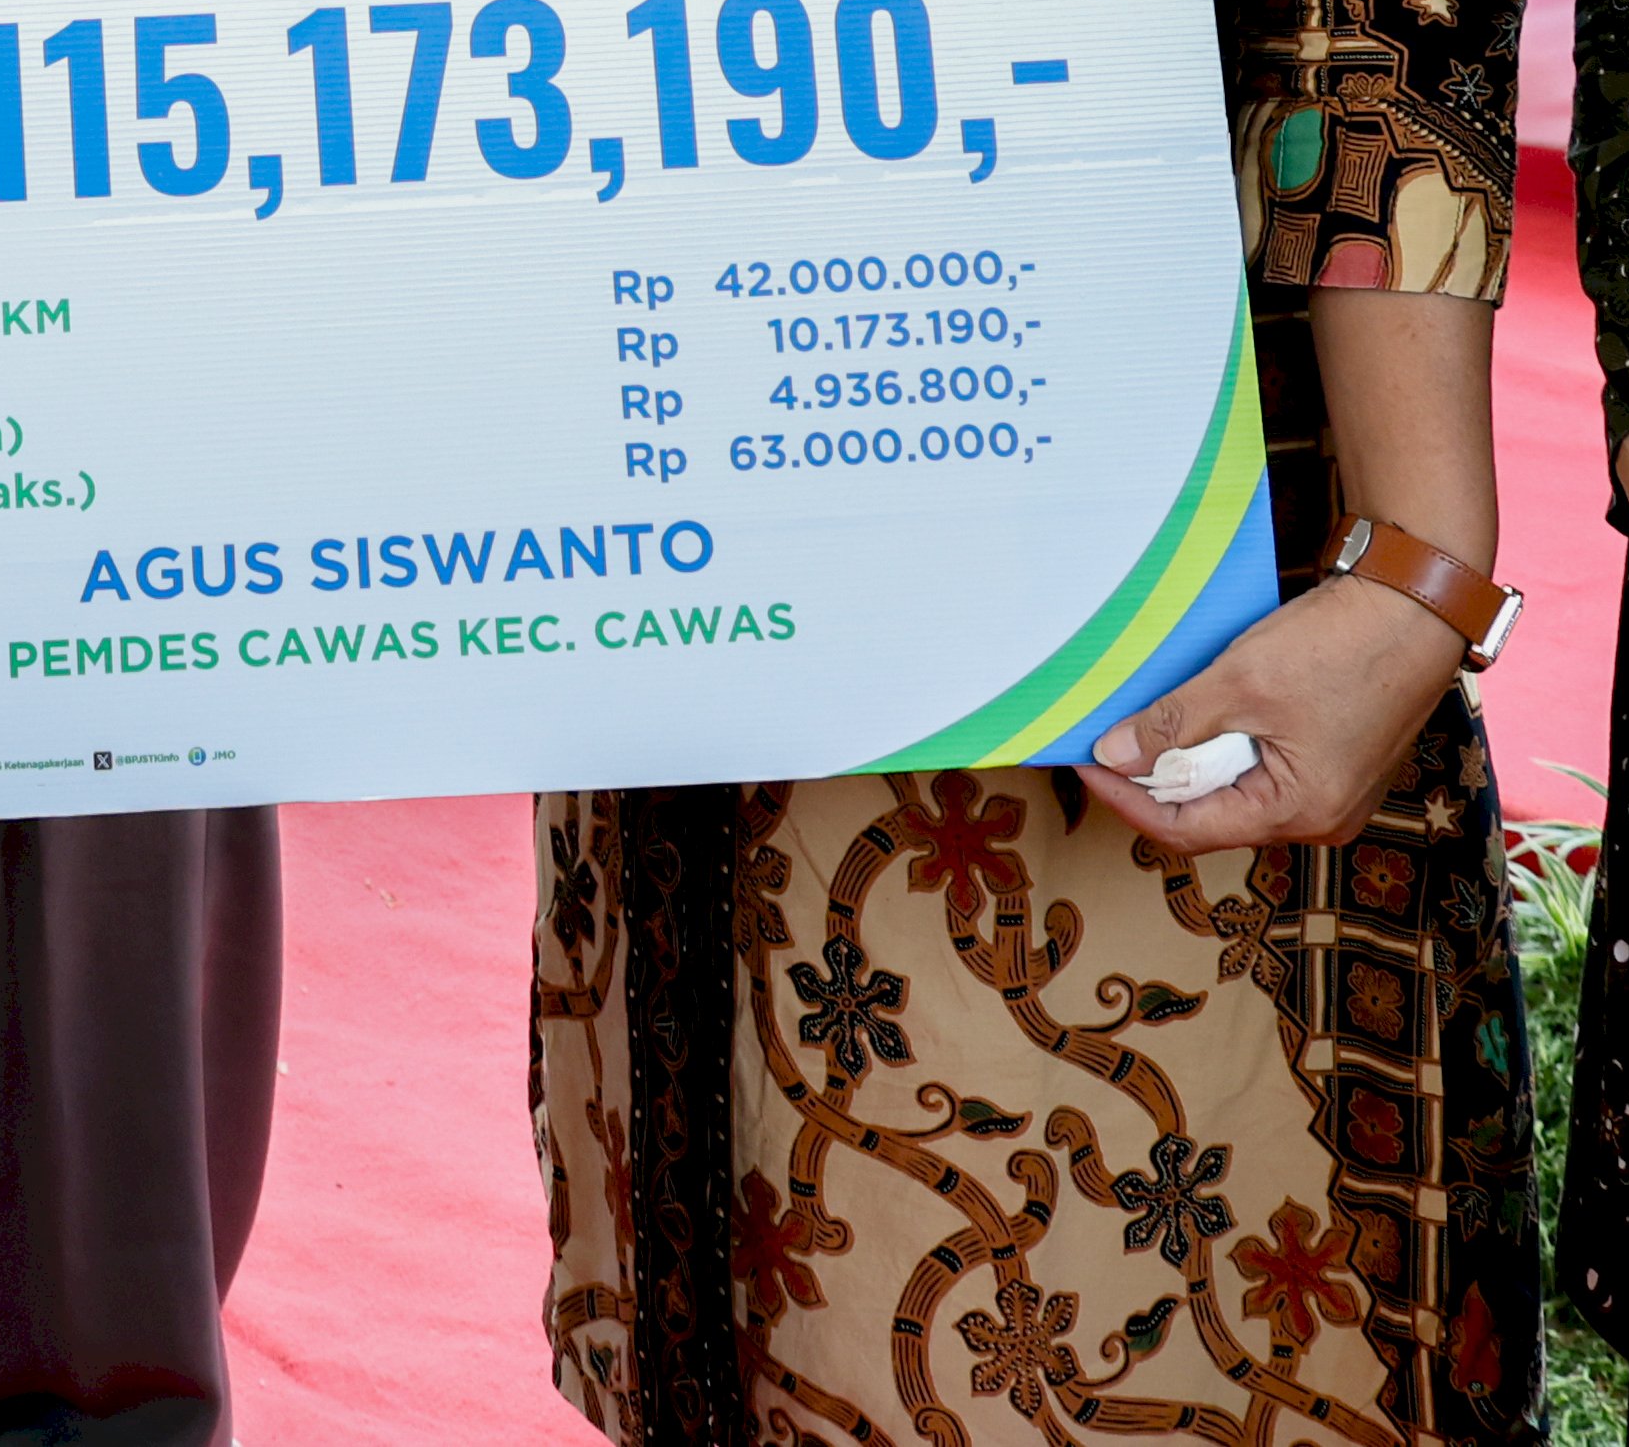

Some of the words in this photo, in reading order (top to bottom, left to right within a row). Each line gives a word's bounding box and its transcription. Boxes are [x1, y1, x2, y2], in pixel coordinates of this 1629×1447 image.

[612, 269, 675, 311] Rp
[714, 249, 1036, 299] 42.000.000,-
[616, 326, 679, 369] Rp
[767, 306, 1041, 354] 10.173.190,-
[620, 384, 683, 426] Rp
[768, 364, 1047, 411] 4.936.800,-
[624, 441, 688, 484] Rp
[729, 421, 1052, 472] 63.000.000,-
[79, 541, 284, 604] AGUS
[310, 519, 714, 592] SISWANTO
[8, 631, 220, 680] PEMDES
[238, 620, 440, 668] CAWAS
[458, 614, 576, 657] KEC.
[594, 602, 796, 650] CAWAS
[4, 758, 85, 772] Ketenagakerjaan
[211, 750, 236, 761] JMO
